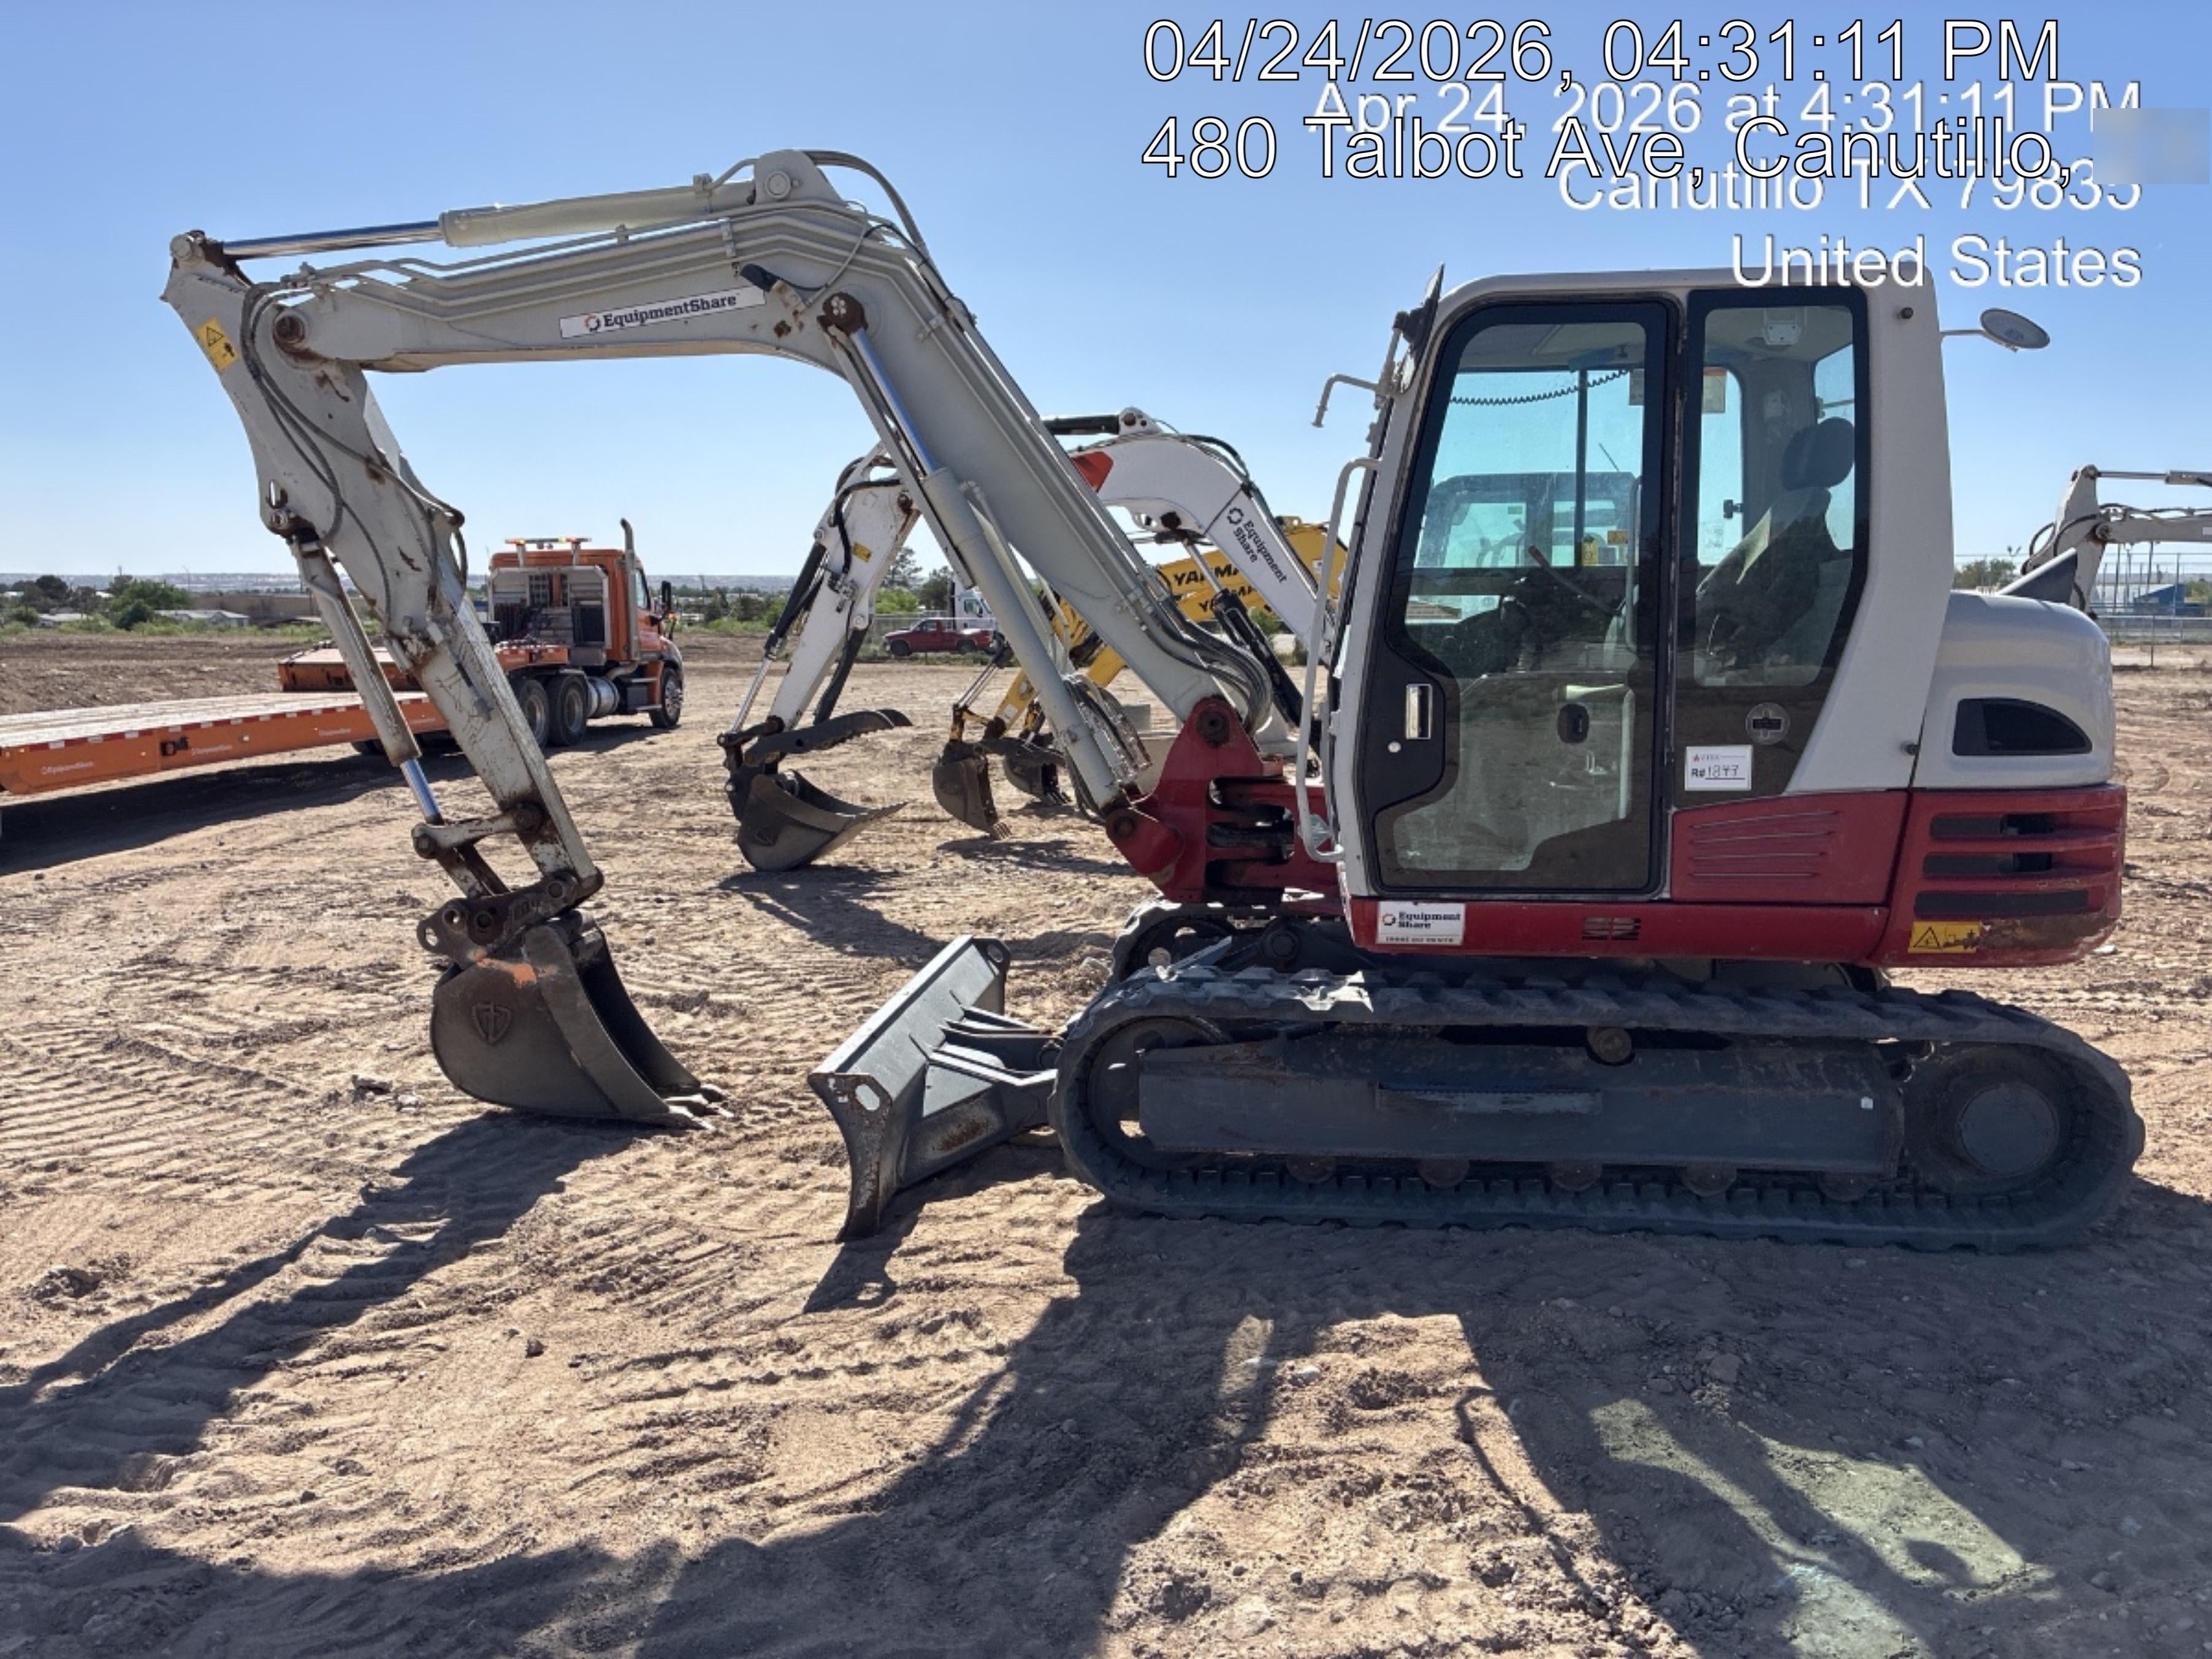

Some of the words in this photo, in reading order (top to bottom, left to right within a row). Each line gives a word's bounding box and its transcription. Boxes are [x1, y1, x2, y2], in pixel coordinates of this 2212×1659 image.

[603, 294, 737, 328] EquipmentShare
[1233, 527, 1258, 563] Share
[1242, 520, 1287, 583] Equipment
